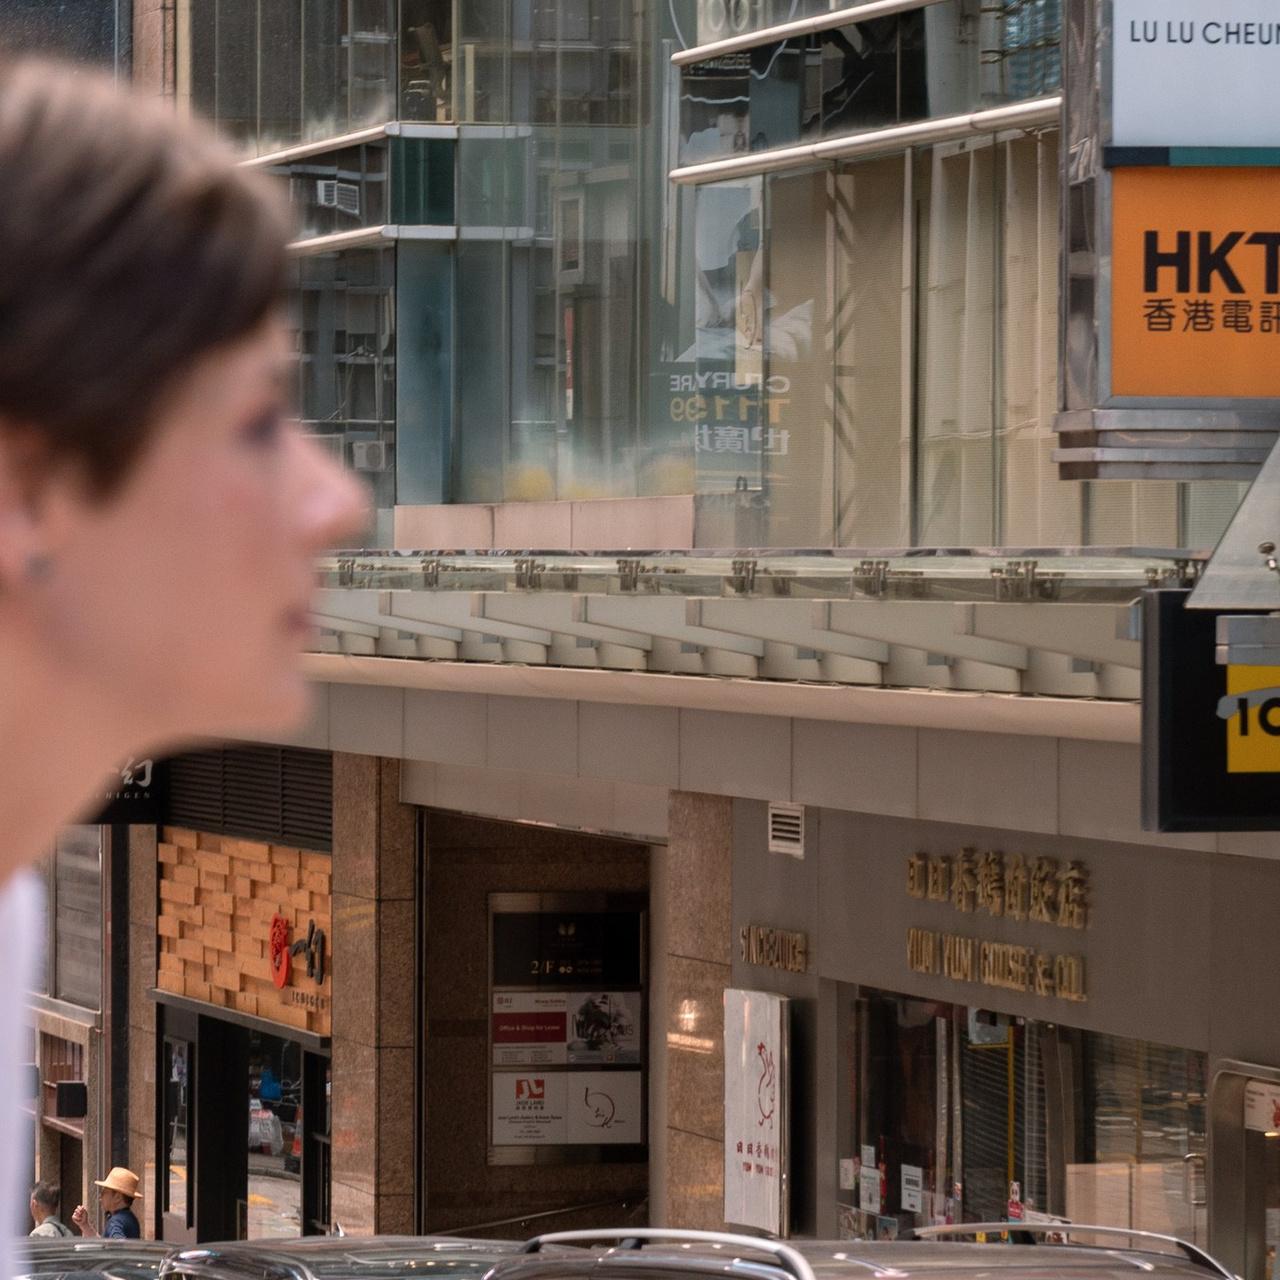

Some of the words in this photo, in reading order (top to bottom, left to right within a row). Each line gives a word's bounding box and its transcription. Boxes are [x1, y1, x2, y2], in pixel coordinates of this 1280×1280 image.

[1131, 20, 1157, 43] LU
[1167, 21, 1194, 44] LU
[1144, 230, 1280, 294] HKT
[1143, 299, 1280, 334] 香港電訊
